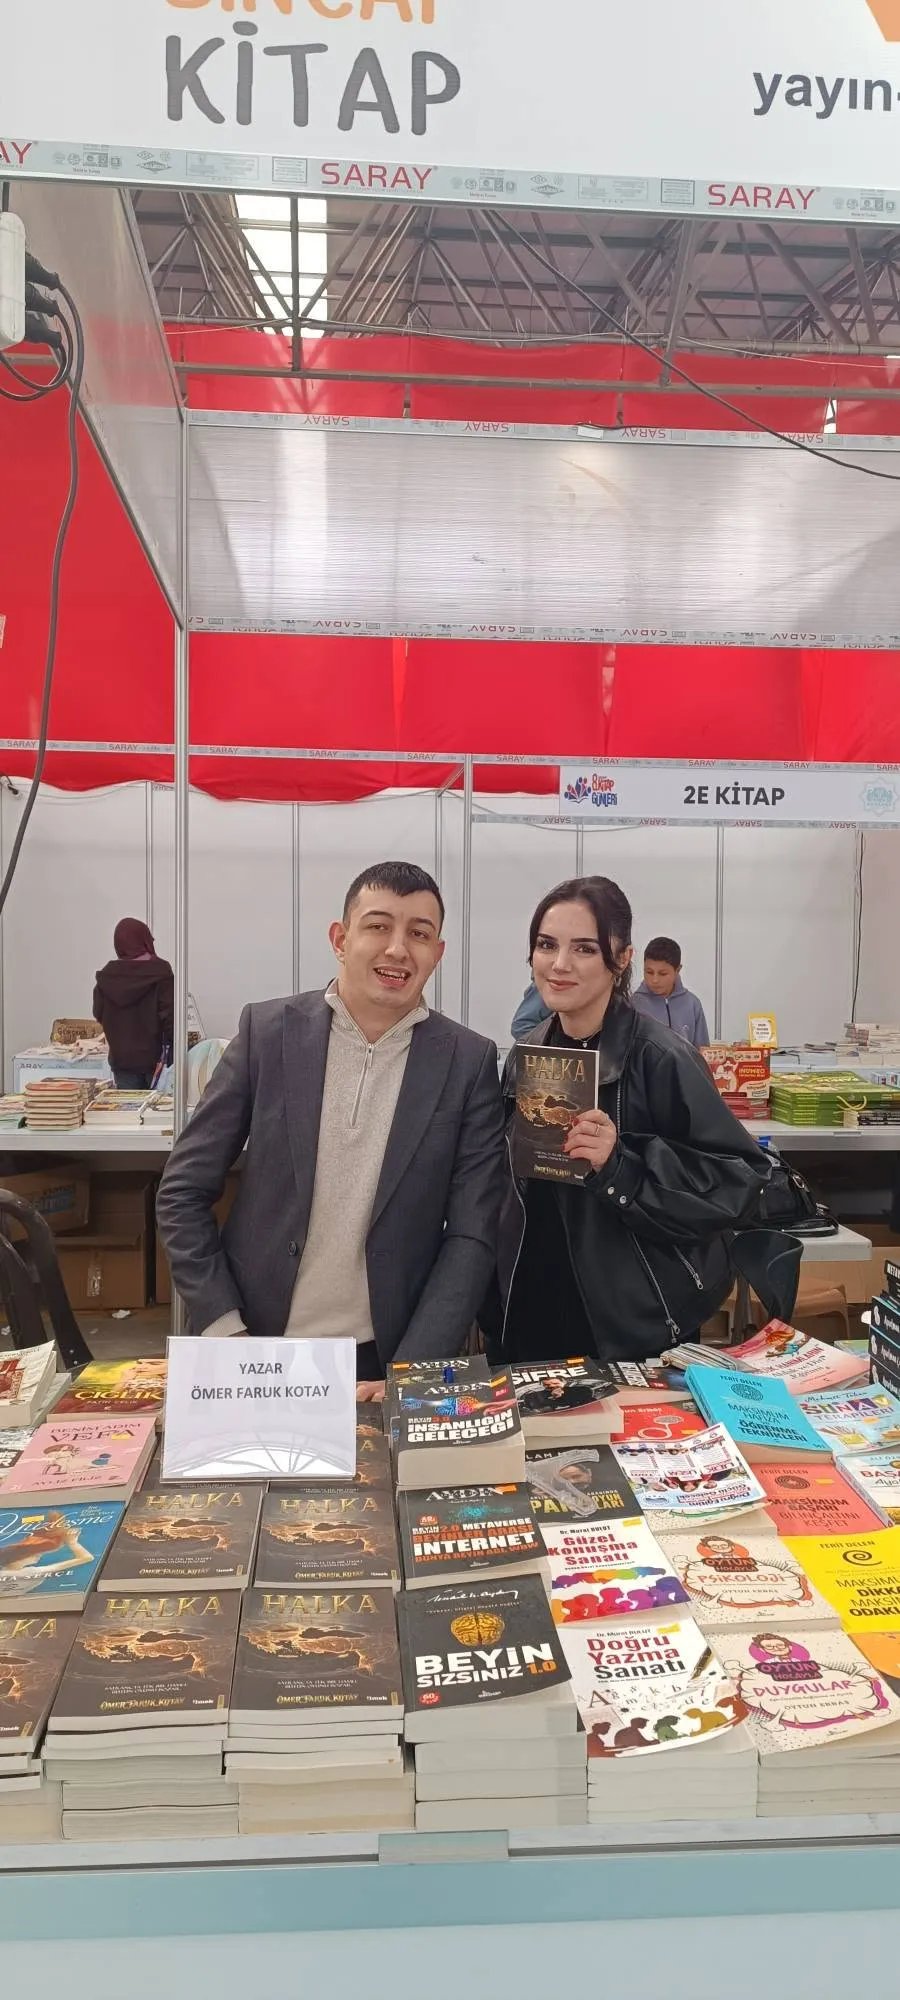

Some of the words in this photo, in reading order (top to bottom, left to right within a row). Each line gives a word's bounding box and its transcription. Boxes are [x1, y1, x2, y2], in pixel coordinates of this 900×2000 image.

[165, 21, 461, 136] KİTAP
[752, 71, 900, 120] yayın
[320, 162, 432, 189] SARAY
[707, 184, 816, 210] SARAY
[304, 416, 350, 426] SARAY
[465, 422, 509, 432] SARAY
[621, 427, 666, 438] SARAY
[7, 740, 36, 748] SARAY
[109, 743, 138, 751] SARAY
[309, 750, 337, 758] SARAY
[683, 785, 709, 804] 2E
[715, 781, 785, 806] KİTAP
[543, 816, 572, 825] SARAY
[639, 818, 667, 826] SARAY
[524, 1055, 585, 1082] HALKA
[239, 1362, 283, 1375] YAZAR
[191, 1385, 233, 1400] ÖMER
[236, 1386, 281, 1399] FARUK
[285, 1385, 330, 1398] KOTAY
[50, 1430, 136, 1443] VEFA
[146, 1492, 243, 1509] HALKA
[279, 1497, 381, 1514] HALKA
[462, 1517, 532, 1531] METAVERSE
[563, 1533, 616, 1546] Güzel
[547, 1541, 638, 1556] Konuşma
[565, 1552, 630, 1566] Sanatı
[706, 1559, 757, 1567] OYTUN
[103, 1596, 224, 1618] HALKA
[262, 1594, 379, 1614] HALKA
[586, 1635, 671, 1651] Doğru
[587, 1648, 680, 1665] Yazma
[527, 1660, 557, 1676] 1.0
[593, 1660, 686, 1679] Sanatı
[761, 1661, 818, 1673] OYTUN
[774, 1672, 821, 1680] HOCAYLA
[753, 1680, 852, 1697] DUYGULAR
